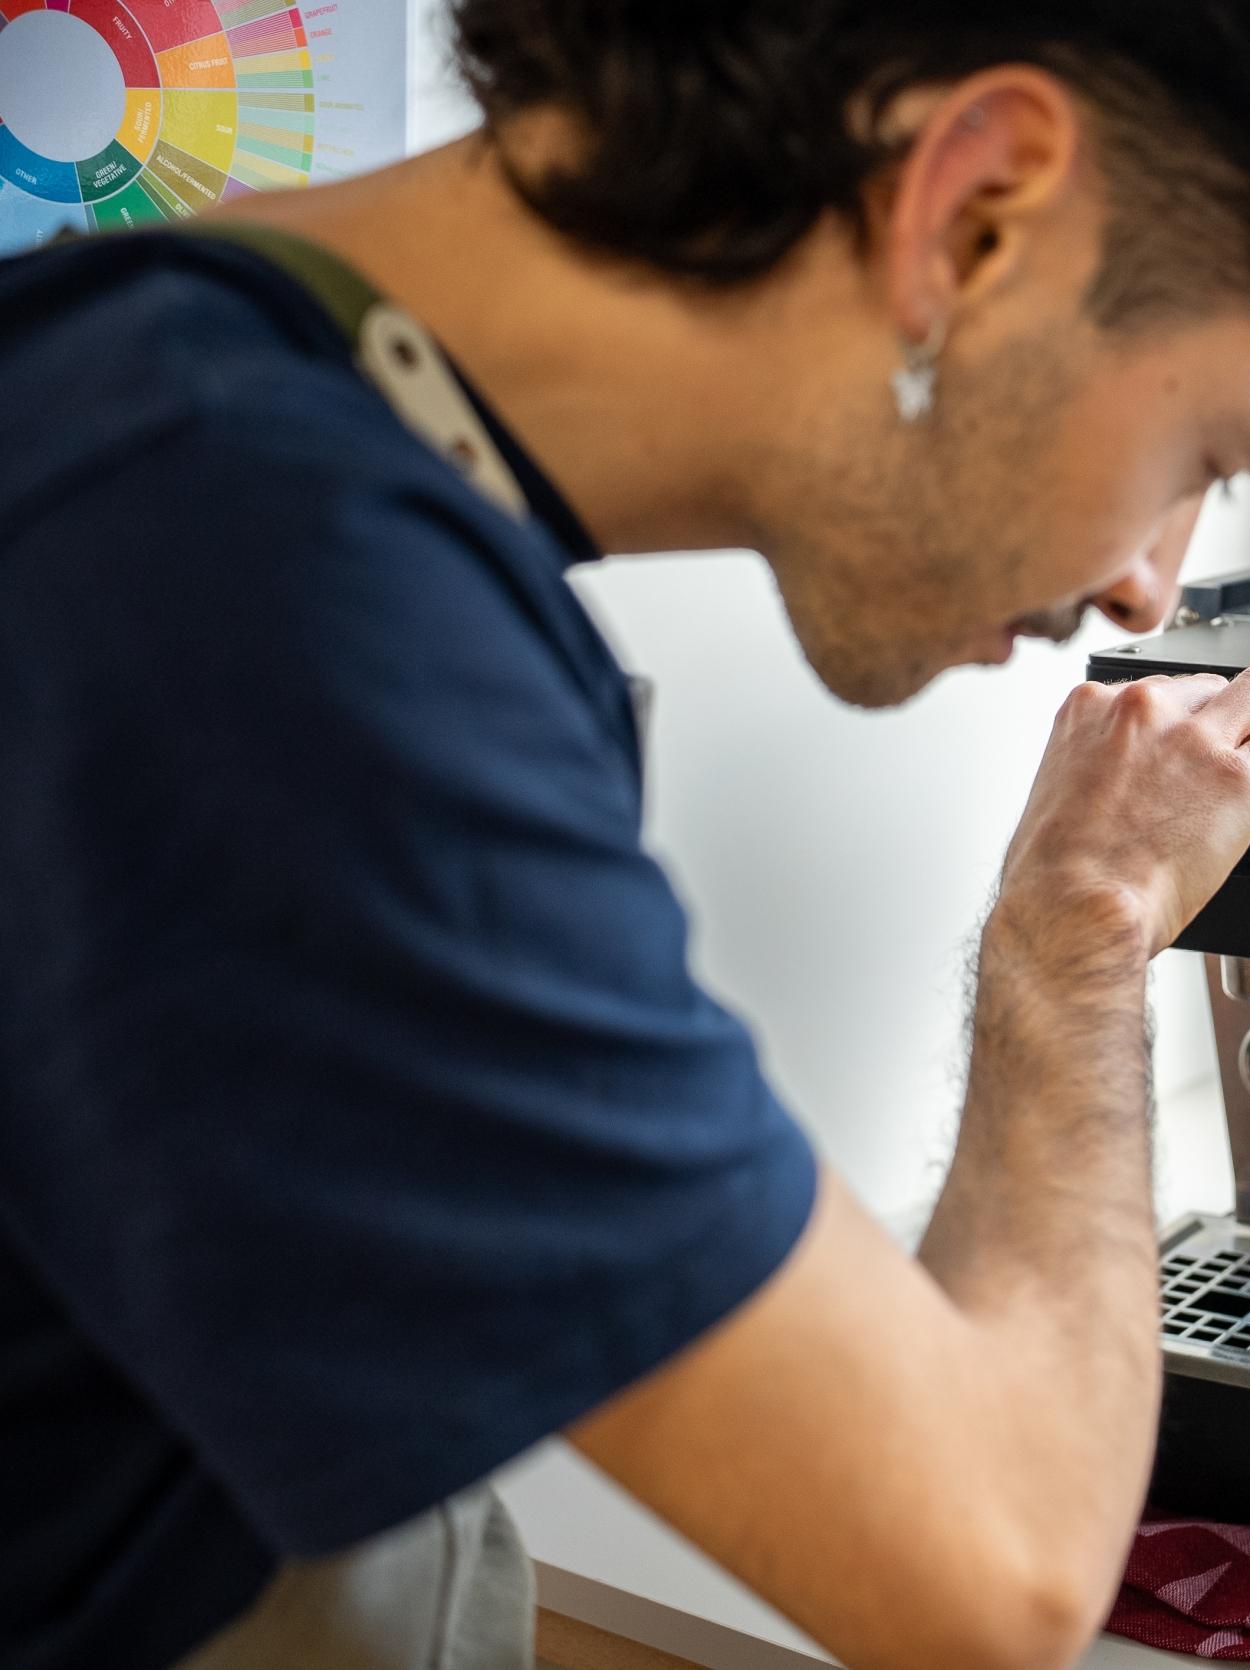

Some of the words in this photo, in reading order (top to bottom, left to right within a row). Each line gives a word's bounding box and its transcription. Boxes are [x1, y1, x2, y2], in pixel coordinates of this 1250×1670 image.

[112, 16, 133, 40] FRUITY
[15, 167, 38, 185] OTHER
[92, 163, 127, 189] VEGETATIVE
[95, 160, 117, 179] GREEN/
[156, 154, 217, 200] ALCOHOL/FERMENTED
[120, 207, 136, 230] GREE
